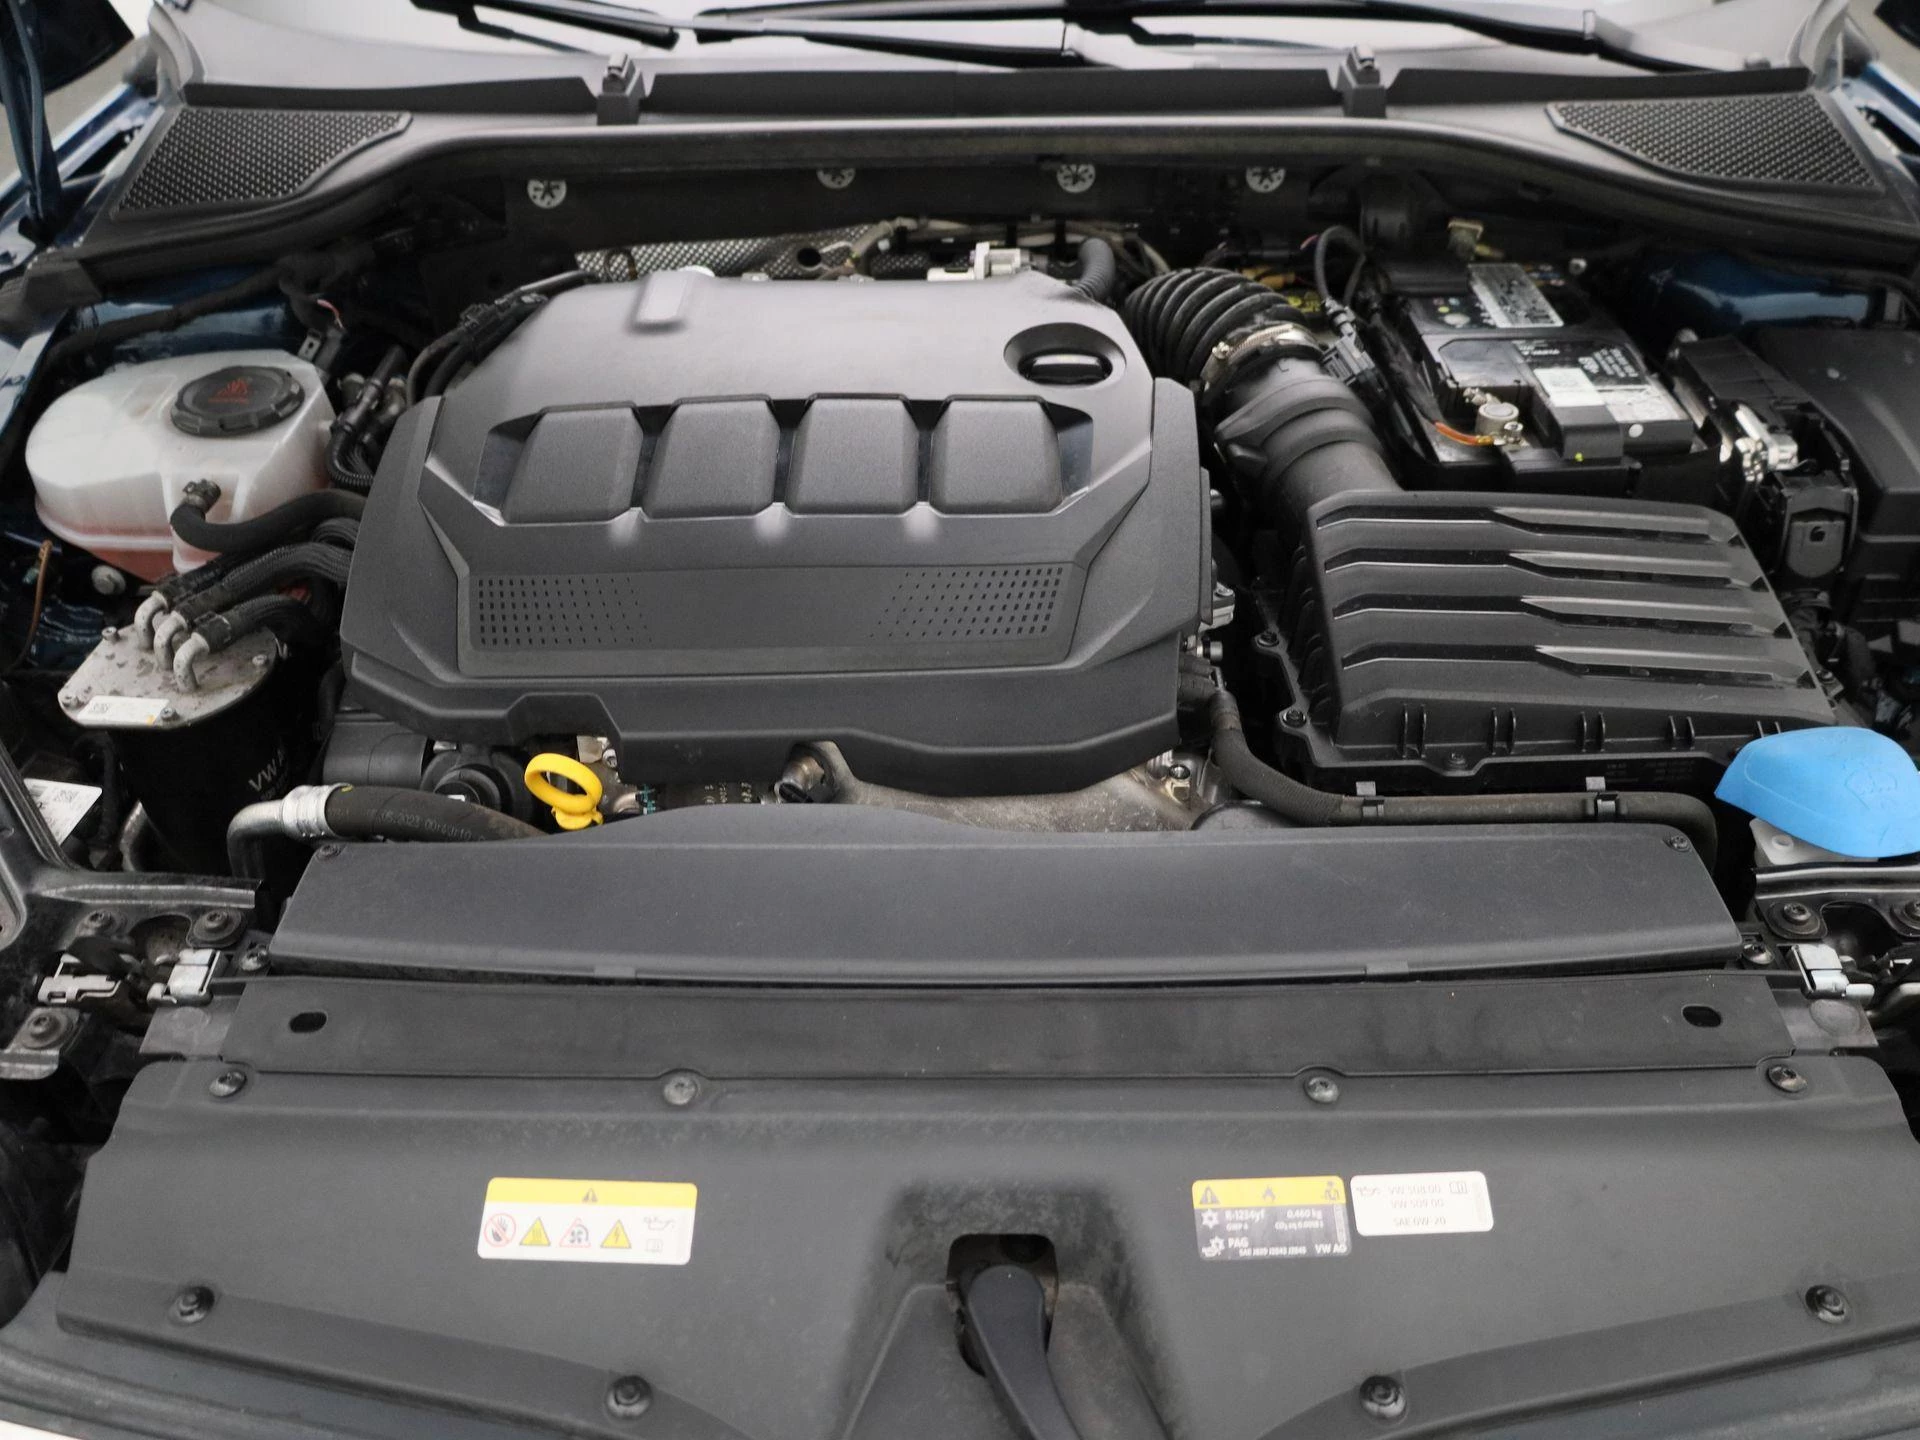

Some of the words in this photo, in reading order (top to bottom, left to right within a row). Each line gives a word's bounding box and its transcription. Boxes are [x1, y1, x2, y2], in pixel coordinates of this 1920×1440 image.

[1228, 1236, 1249, 1249] PAG
[1315, 1243, 1332, 1255] VW
[1333, 1243, 1348, 1254] AG
